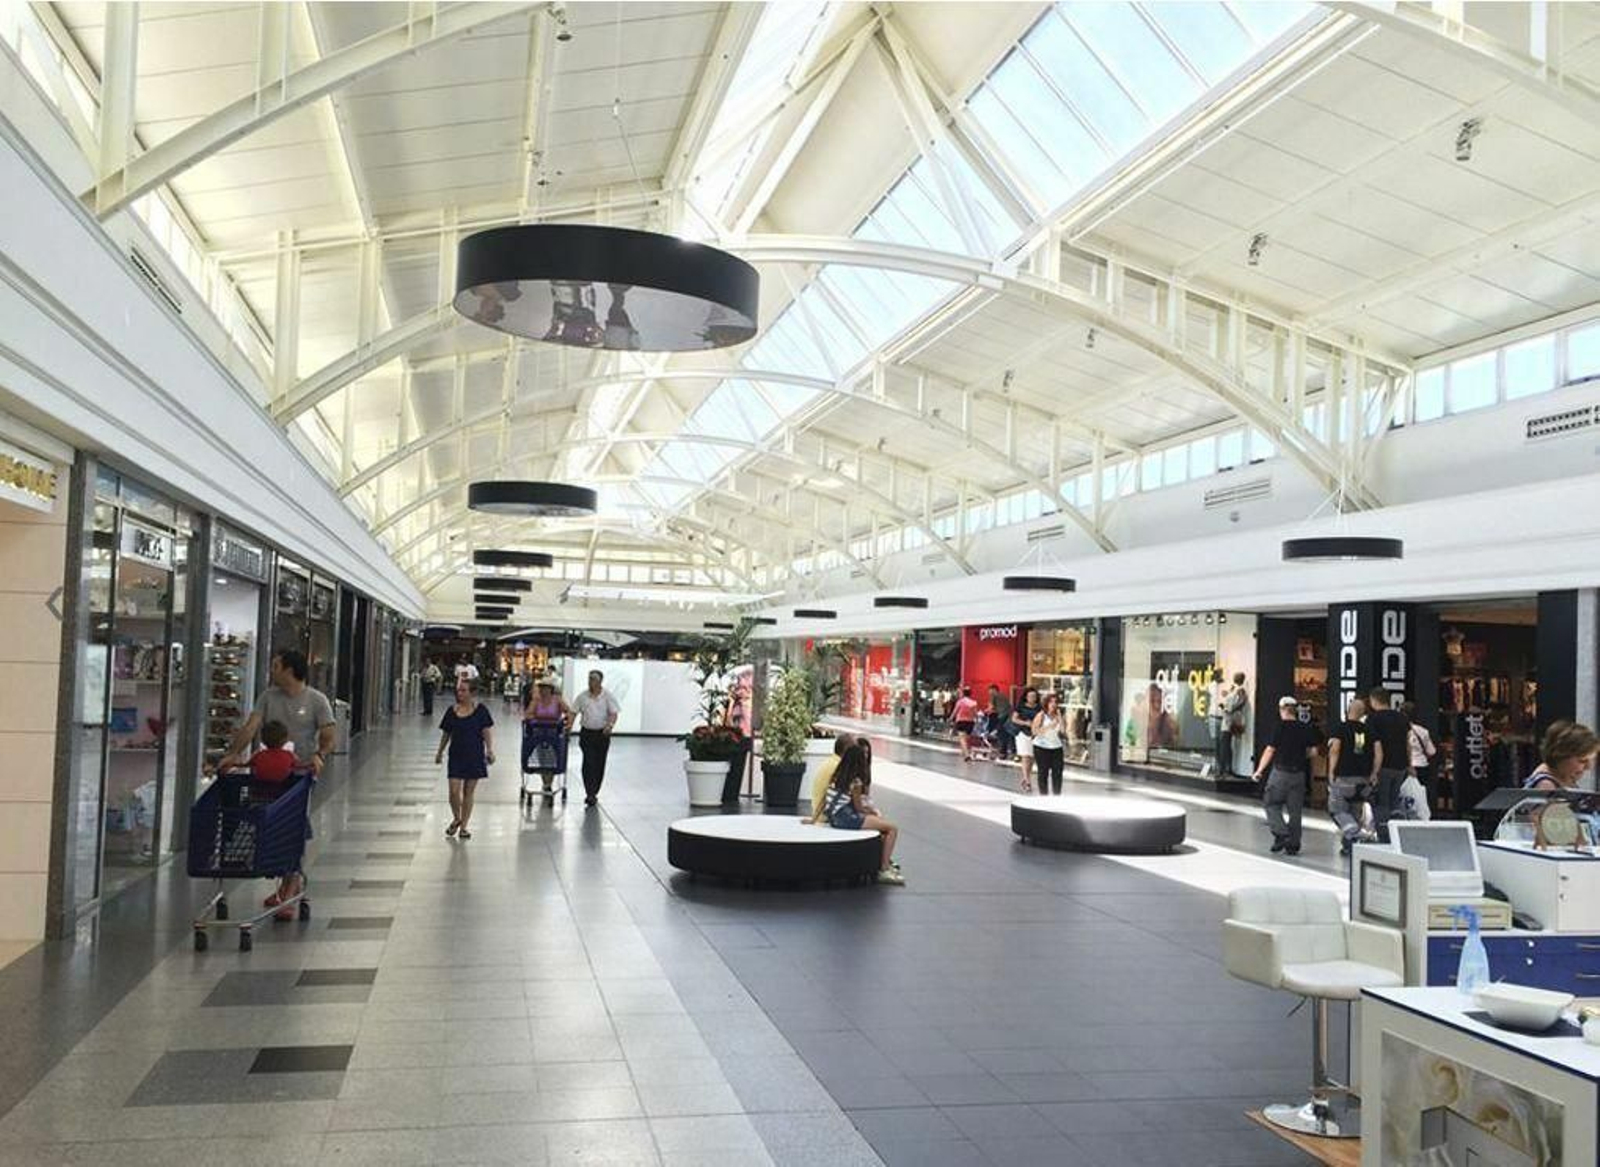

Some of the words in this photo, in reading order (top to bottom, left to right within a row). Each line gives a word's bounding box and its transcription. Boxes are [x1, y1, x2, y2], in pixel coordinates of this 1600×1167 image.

[980, 624, 1018, 641] promod
[1156, 664, 1180, 690] out
[1188, 663, 1214, 691] out
[1465, 713, 1484, 779] outlet
